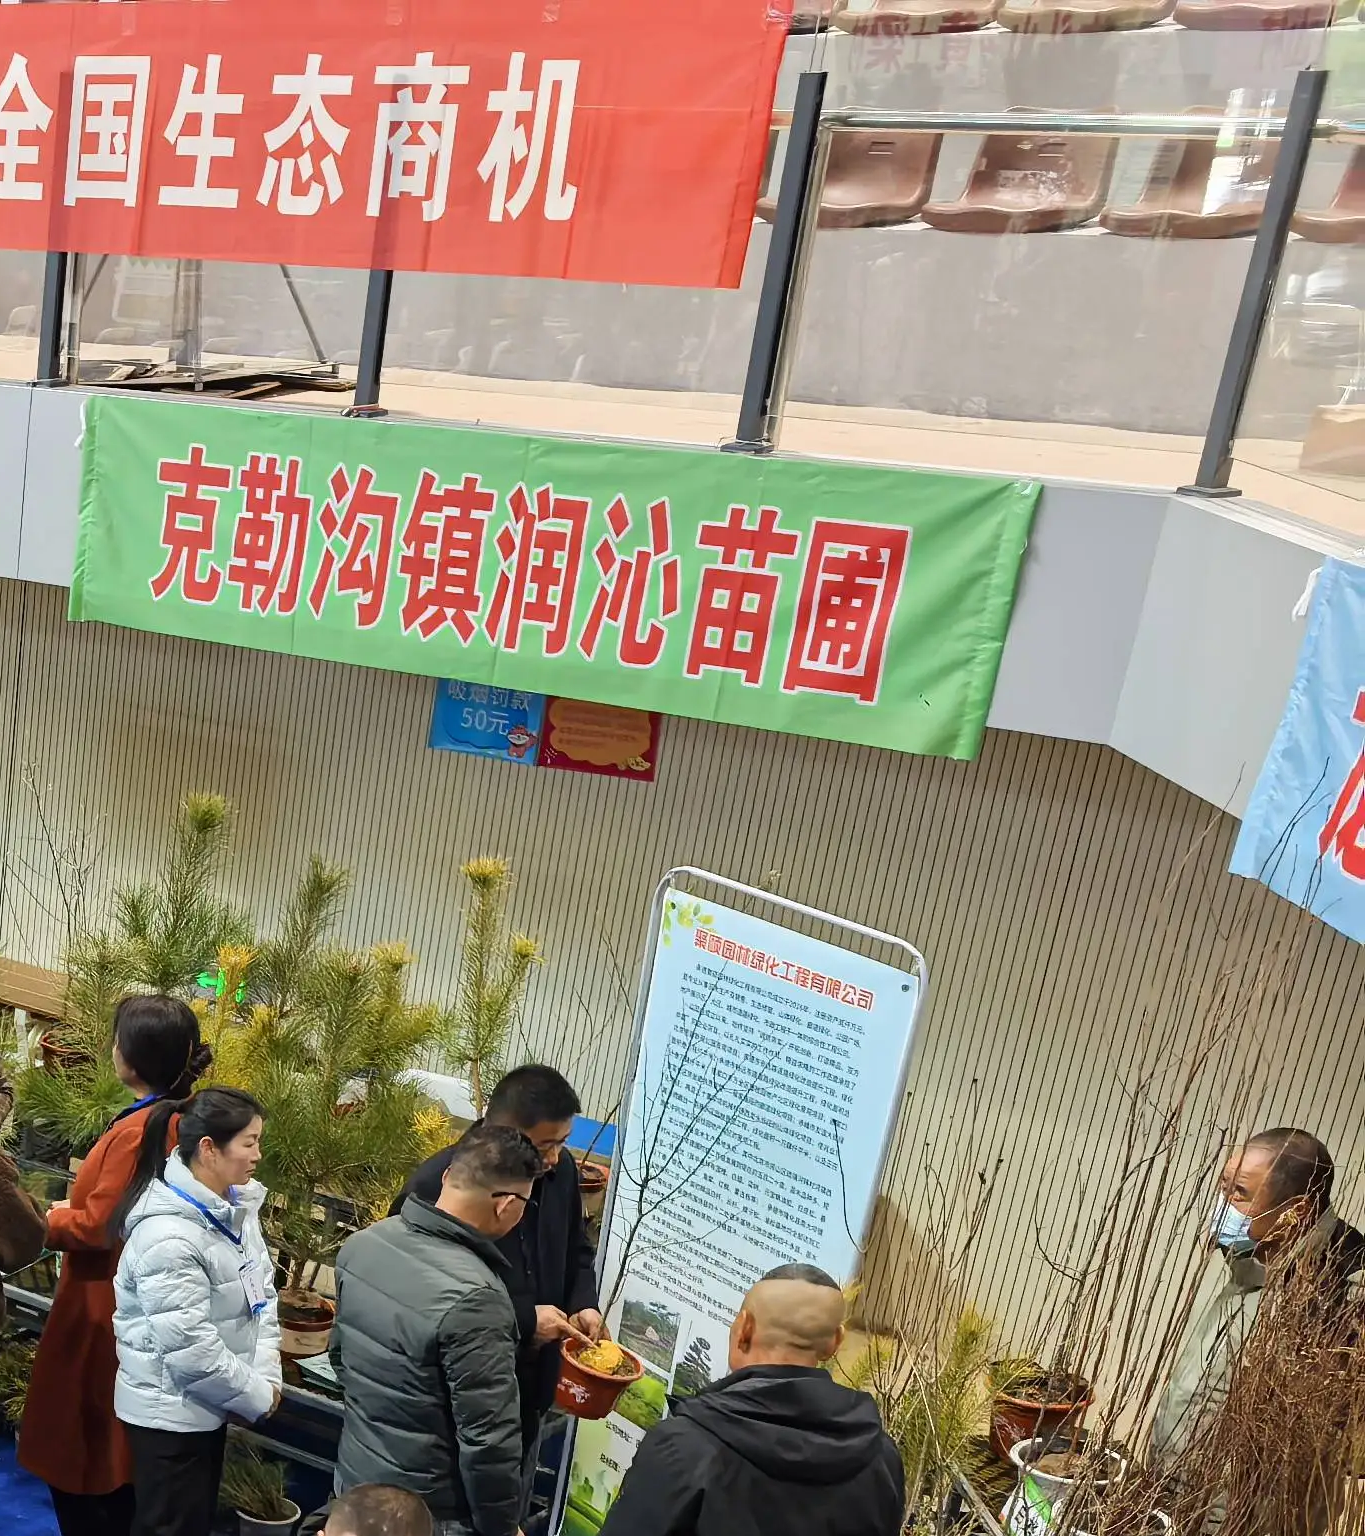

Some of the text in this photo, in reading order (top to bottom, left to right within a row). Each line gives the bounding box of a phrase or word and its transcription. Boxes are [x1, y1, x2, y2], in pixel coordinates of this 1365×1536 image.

[149, 441, 915, 706] 克勒沟镇润沁苗圃
[460, 708, 510, 737] 50元
